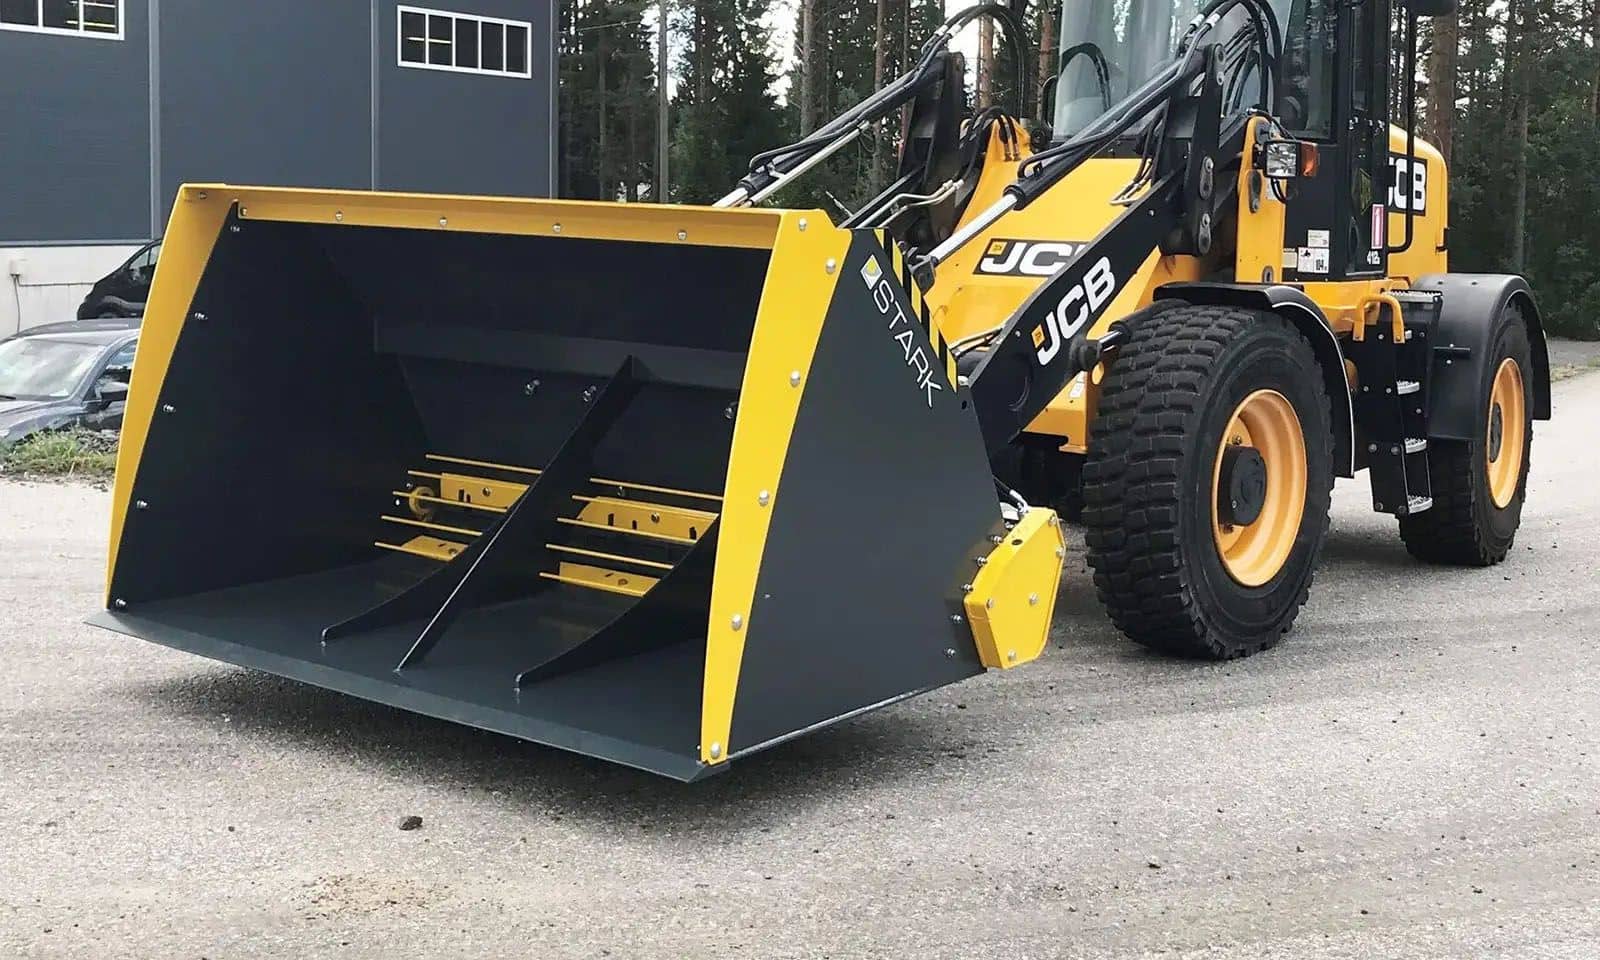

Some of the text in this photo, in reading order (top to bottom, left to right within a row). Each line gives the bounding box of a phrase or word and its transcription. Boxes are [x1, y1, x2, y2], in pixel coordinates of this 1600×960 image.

[980, 242, 1086, 275] JC
[1037, 255, 1117, 367] JCB
[872, 279, 943, 409] STARK
